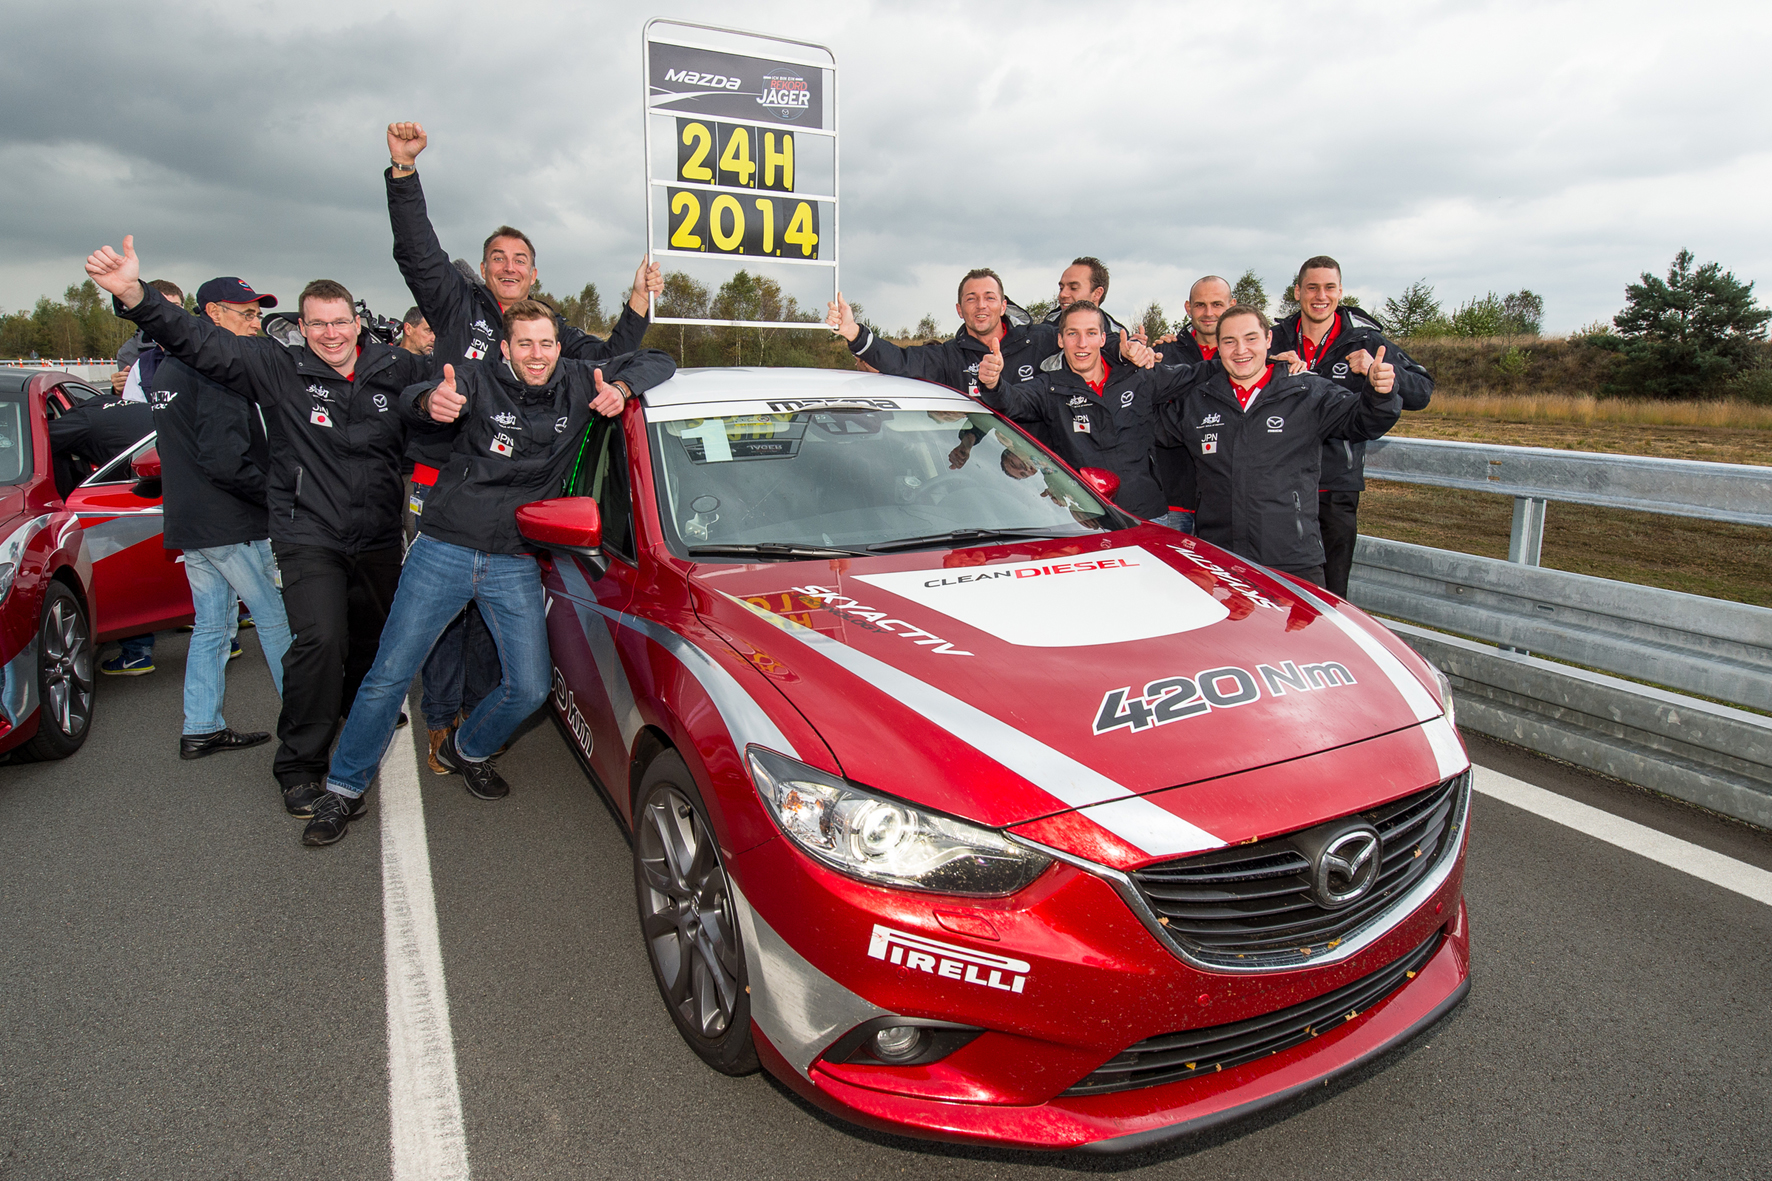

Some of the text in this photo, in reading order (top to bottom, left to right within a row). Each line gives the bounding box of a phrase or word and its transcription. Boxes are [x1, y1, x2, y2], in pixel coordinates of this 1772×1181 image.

[755, 87, 811, 106] JÄGER
[771, 79, 808, 91] REKORD
[681, 122, 794, 190] 24H
[670, 190, 819, 257] 2014
[470, 338, 489, 352] JPN
[1073, 414, 1090, 423] JPN
[493, 432, 515, 447] JPN
[1201, 432, 1219, 442] JPN
[924, 558, 1140, 588] CLEAN DIESEL
[791, 585, 975, 657] SKYACTIV
[1091, 660, 1359, 736] 420 Nm
[567, 690, 594, 759] km
[867, 923, 1031, 994] PIRELLI
